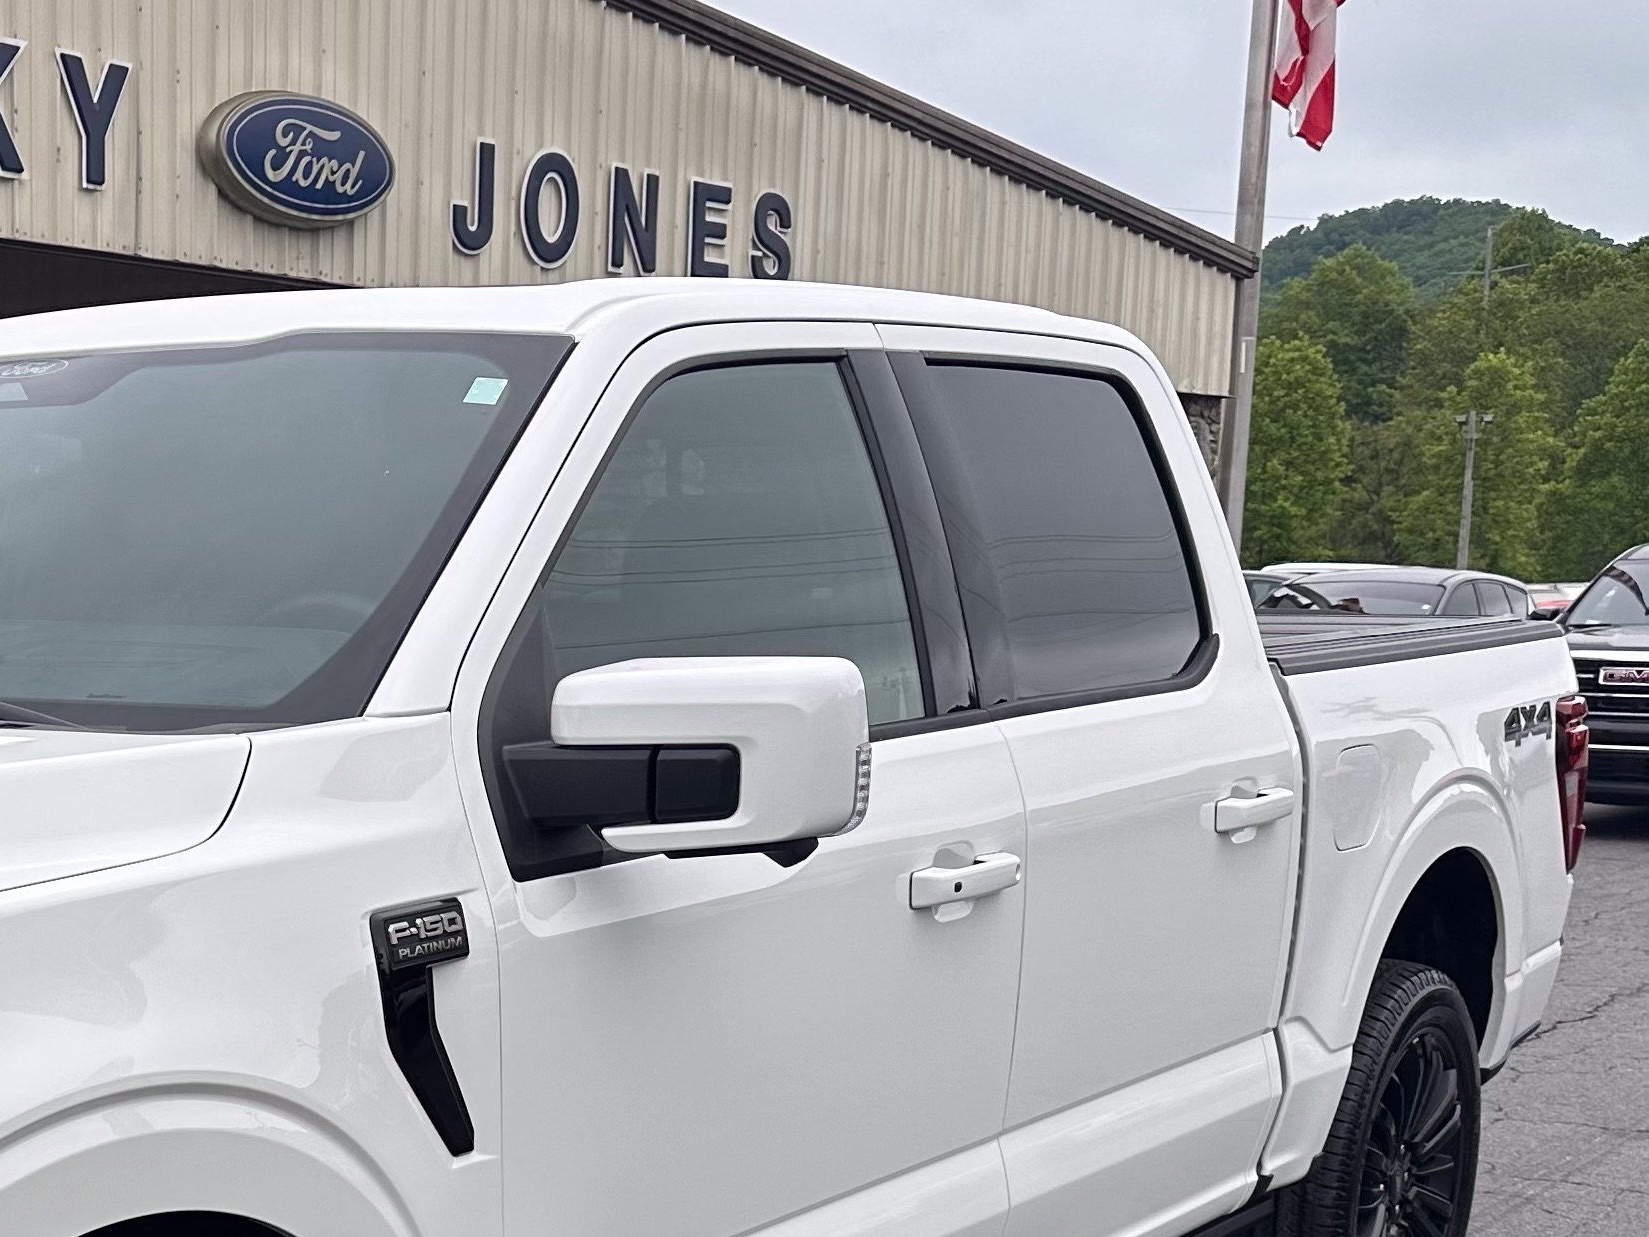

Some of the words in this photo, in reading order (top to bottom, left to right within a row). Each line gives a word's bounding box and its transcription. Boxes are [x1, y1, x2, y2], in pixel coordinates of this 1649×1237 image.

[263, 117, 366, 197] Ford
[451, 136, 792, 280] JONES
[1603, 669, 1649, 683] GM
[388, 911, 463, 945] F-150
[398, 936, 463, 959] PLATINUM
